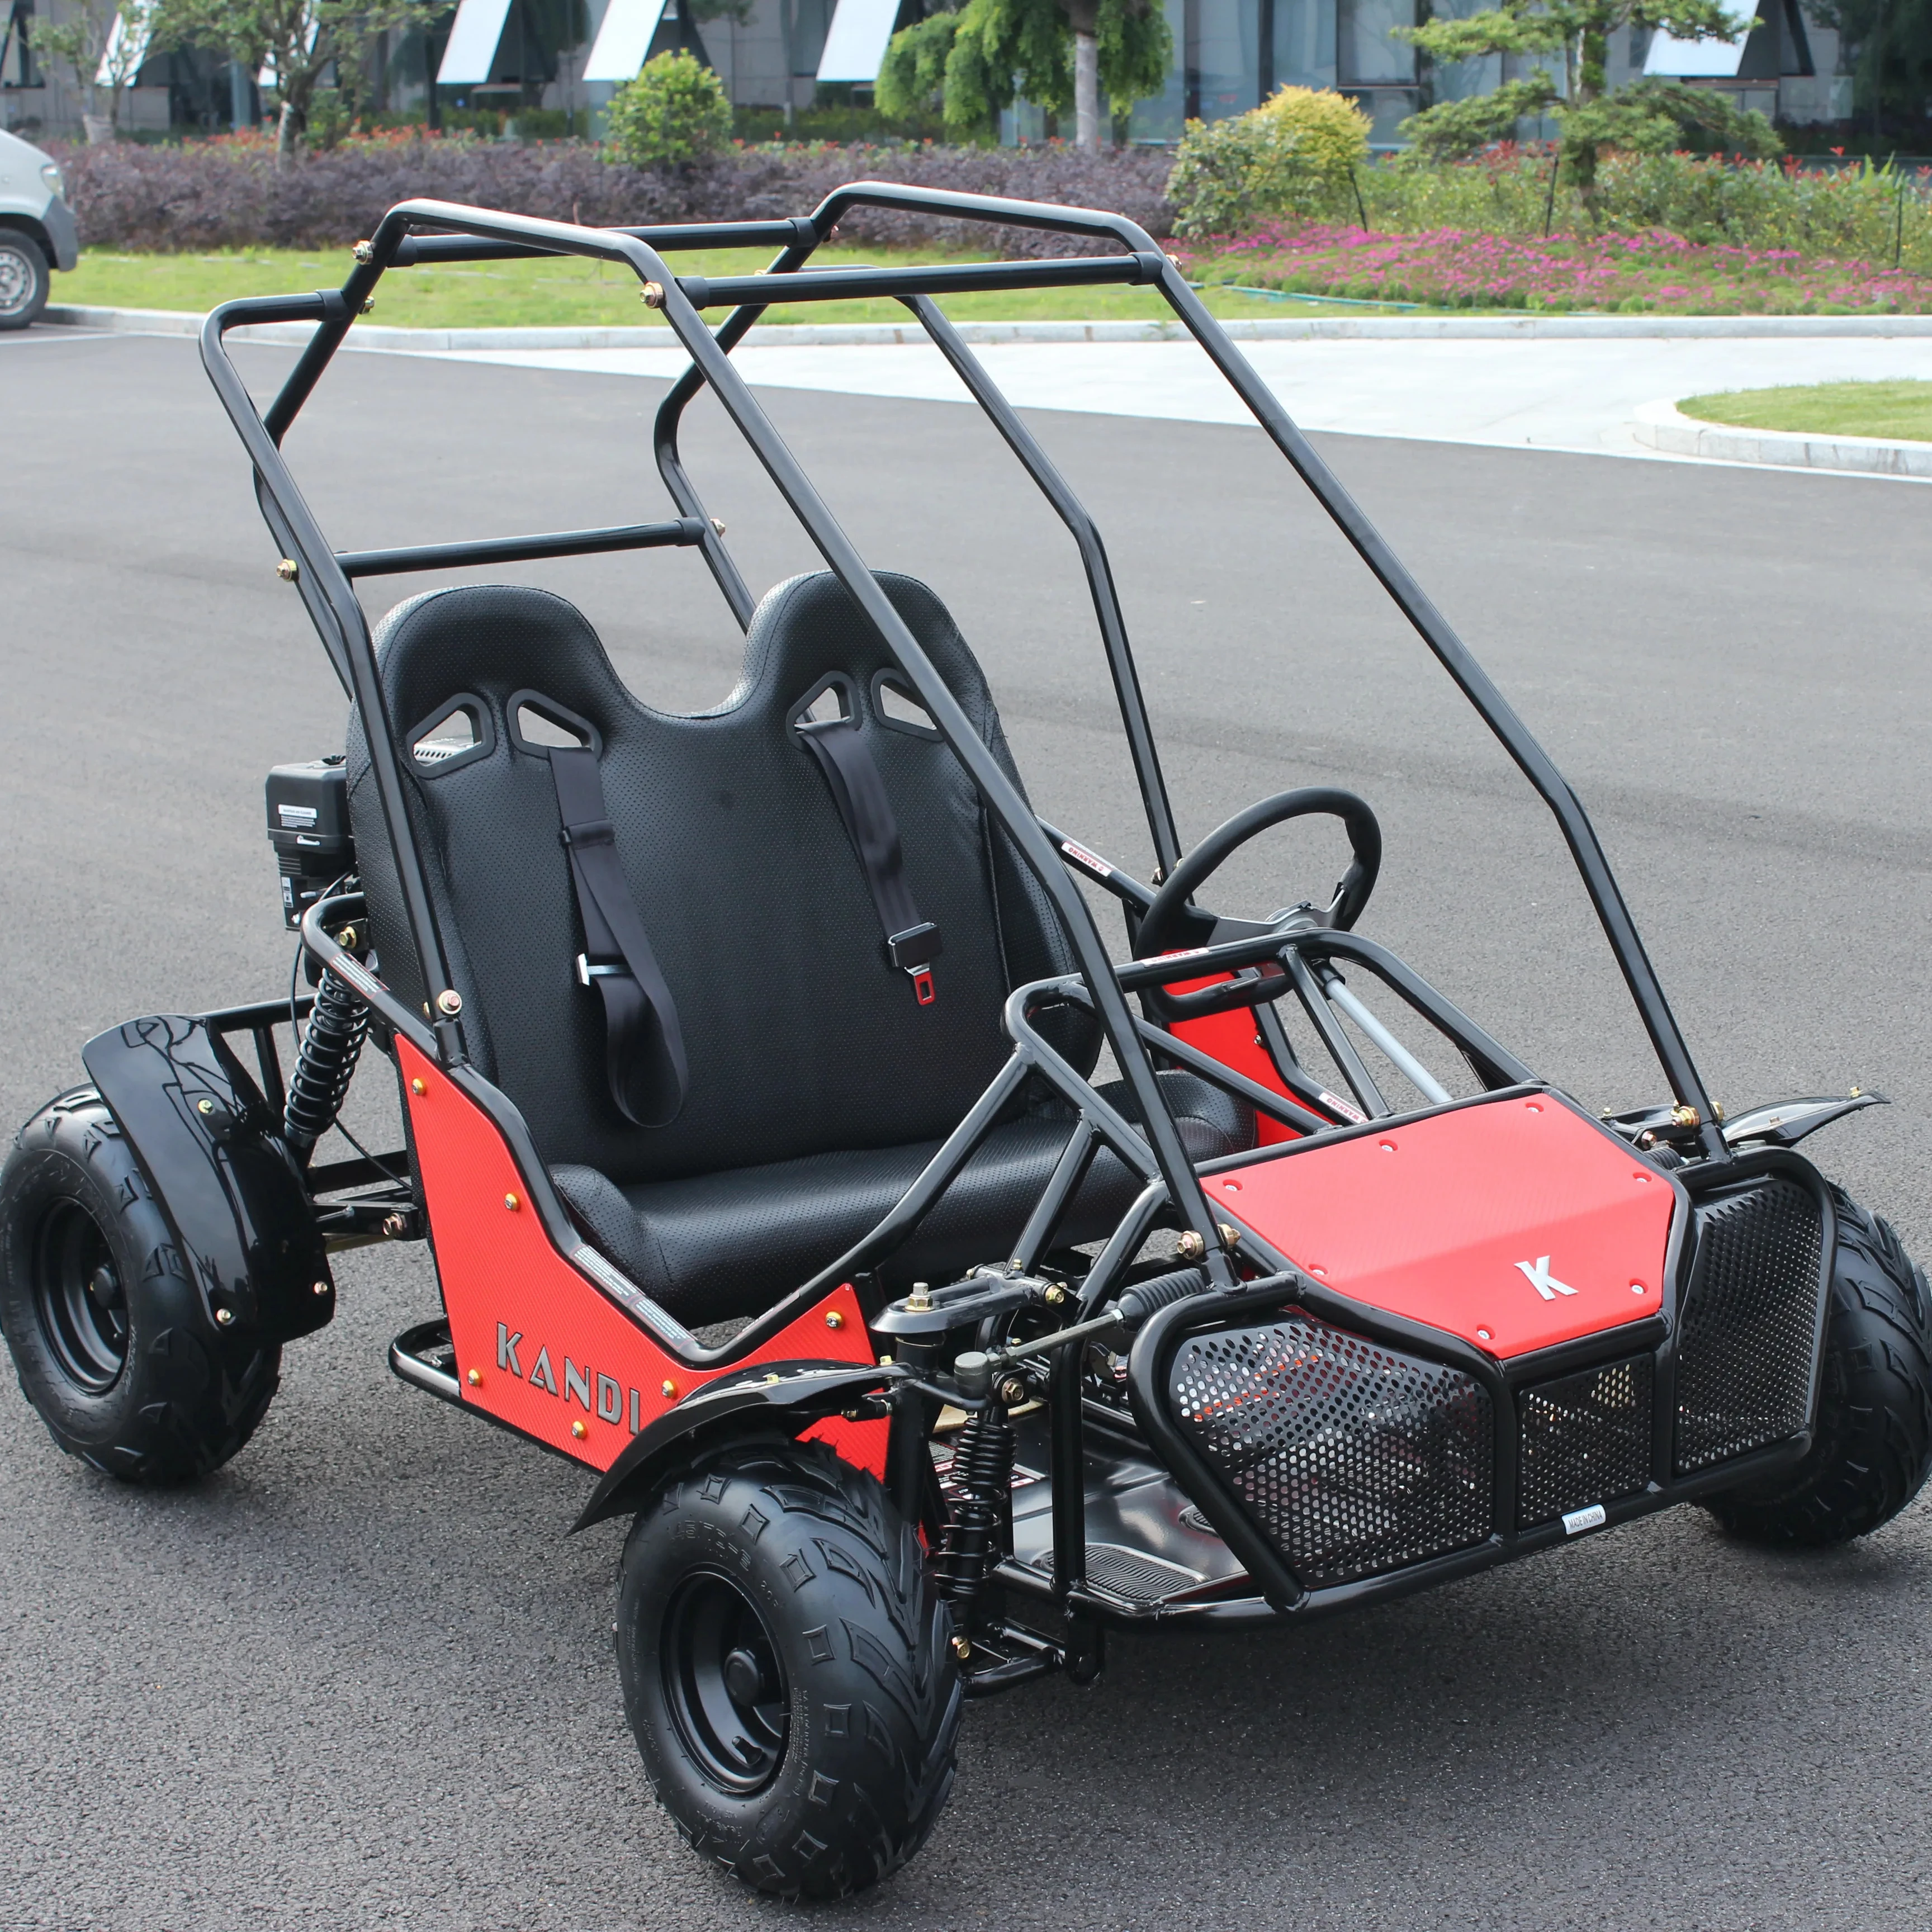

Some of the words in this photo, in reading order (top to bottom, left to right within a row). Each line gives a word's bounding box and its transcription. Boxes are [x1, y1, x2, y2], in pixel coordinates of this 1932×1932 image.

[1068, 847, 1098, 868] WARNING
[1327, 1098, 1360, 1120] WARNING
[1514, 1255, 1579, 1301] K
[496, 1320, 641, 1436] KANDI
[1568, 1516, 1583, 1528] MADE
[1581, 1514, 1589, 1524] IN
[1588, 1510, 1603, 1523] CHINA
